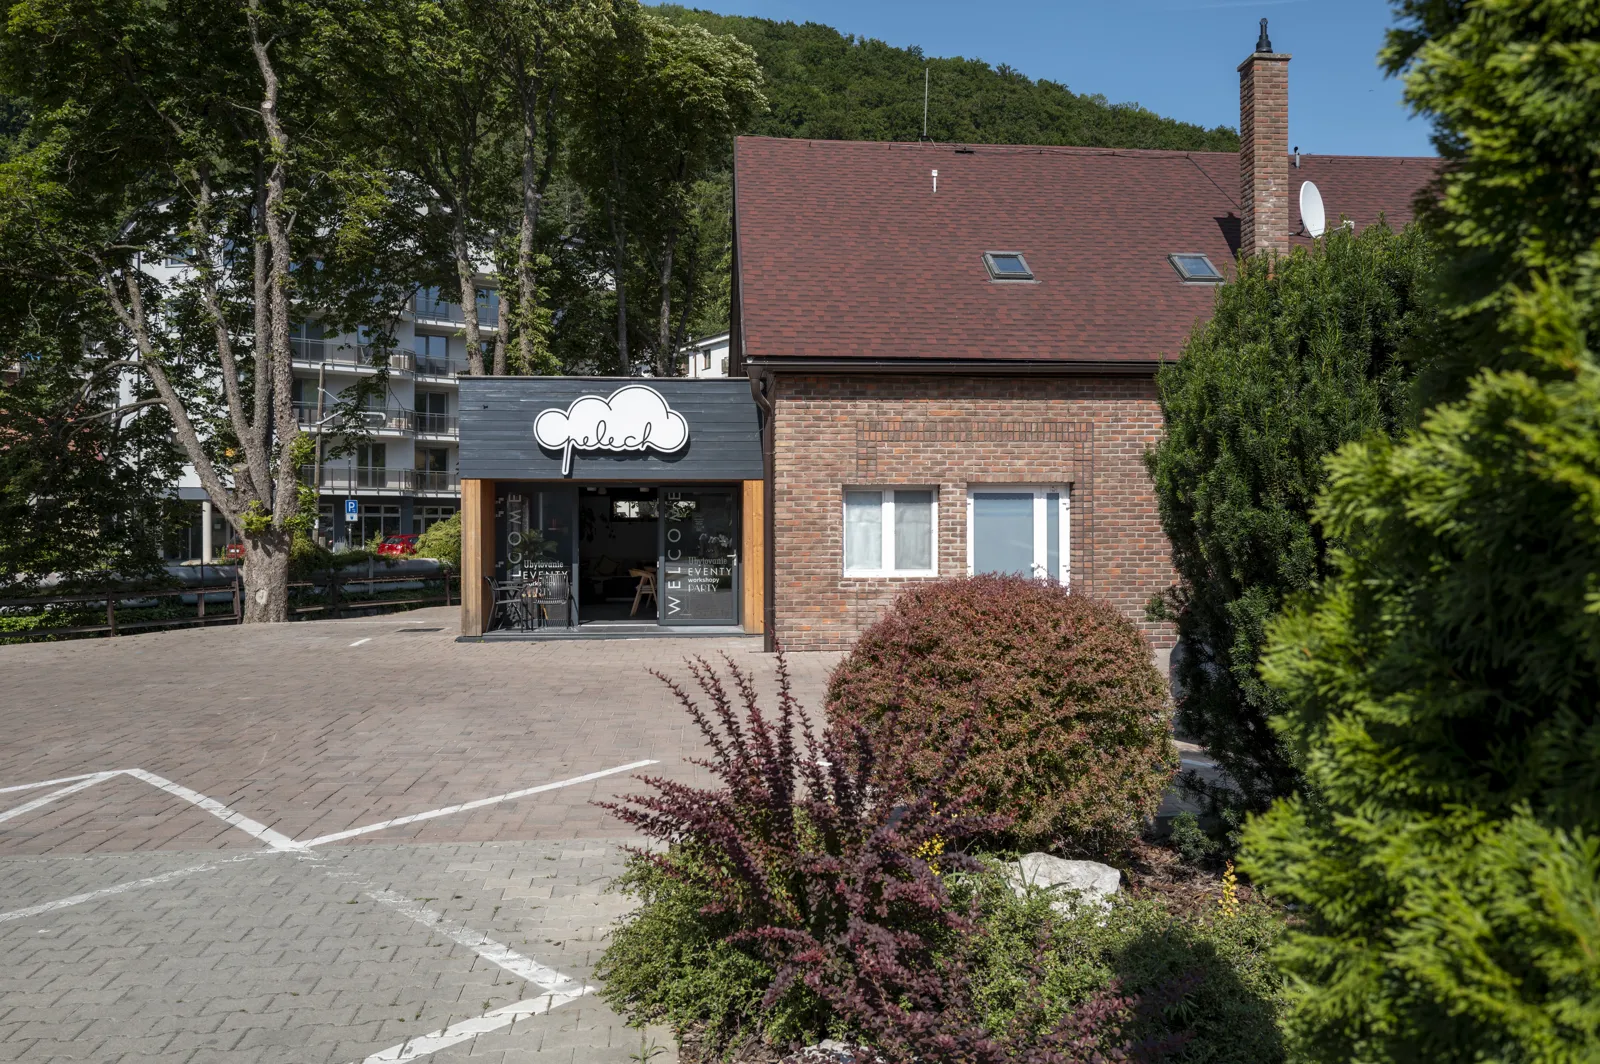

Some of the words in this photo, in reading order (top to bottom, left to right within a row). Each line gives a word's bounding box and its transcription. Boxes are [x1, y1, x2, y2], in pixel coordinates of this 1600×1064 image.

[561, 419, 653, 474] pelech
[348, 501, 356, 513] P
[687, 567, 732, 576] EVENTY
[687, 584, 719, 593] PARTY
